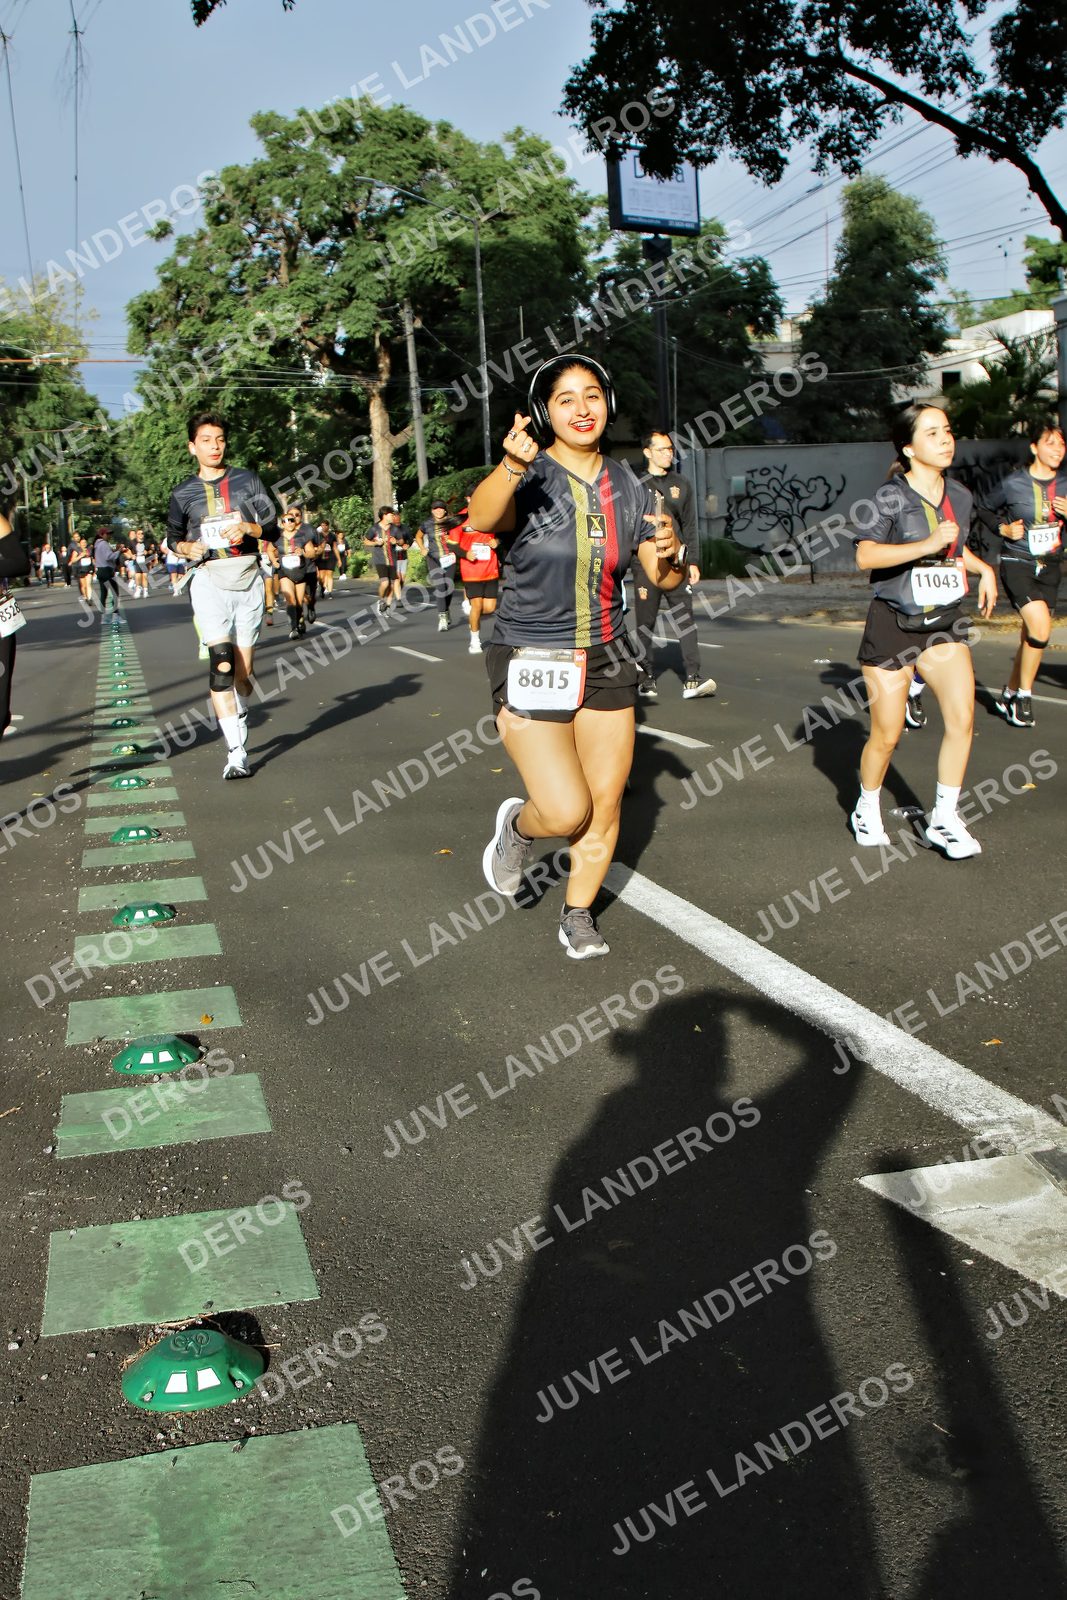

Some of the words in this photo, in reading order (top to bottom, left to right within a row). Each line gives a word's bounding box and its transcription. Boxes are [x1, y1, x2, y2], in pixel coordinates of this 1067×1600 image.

[747, 464, 787, 480] TOY
[915, 573, 959, 588] 11043
[518, 668, 570, 690] 8815
